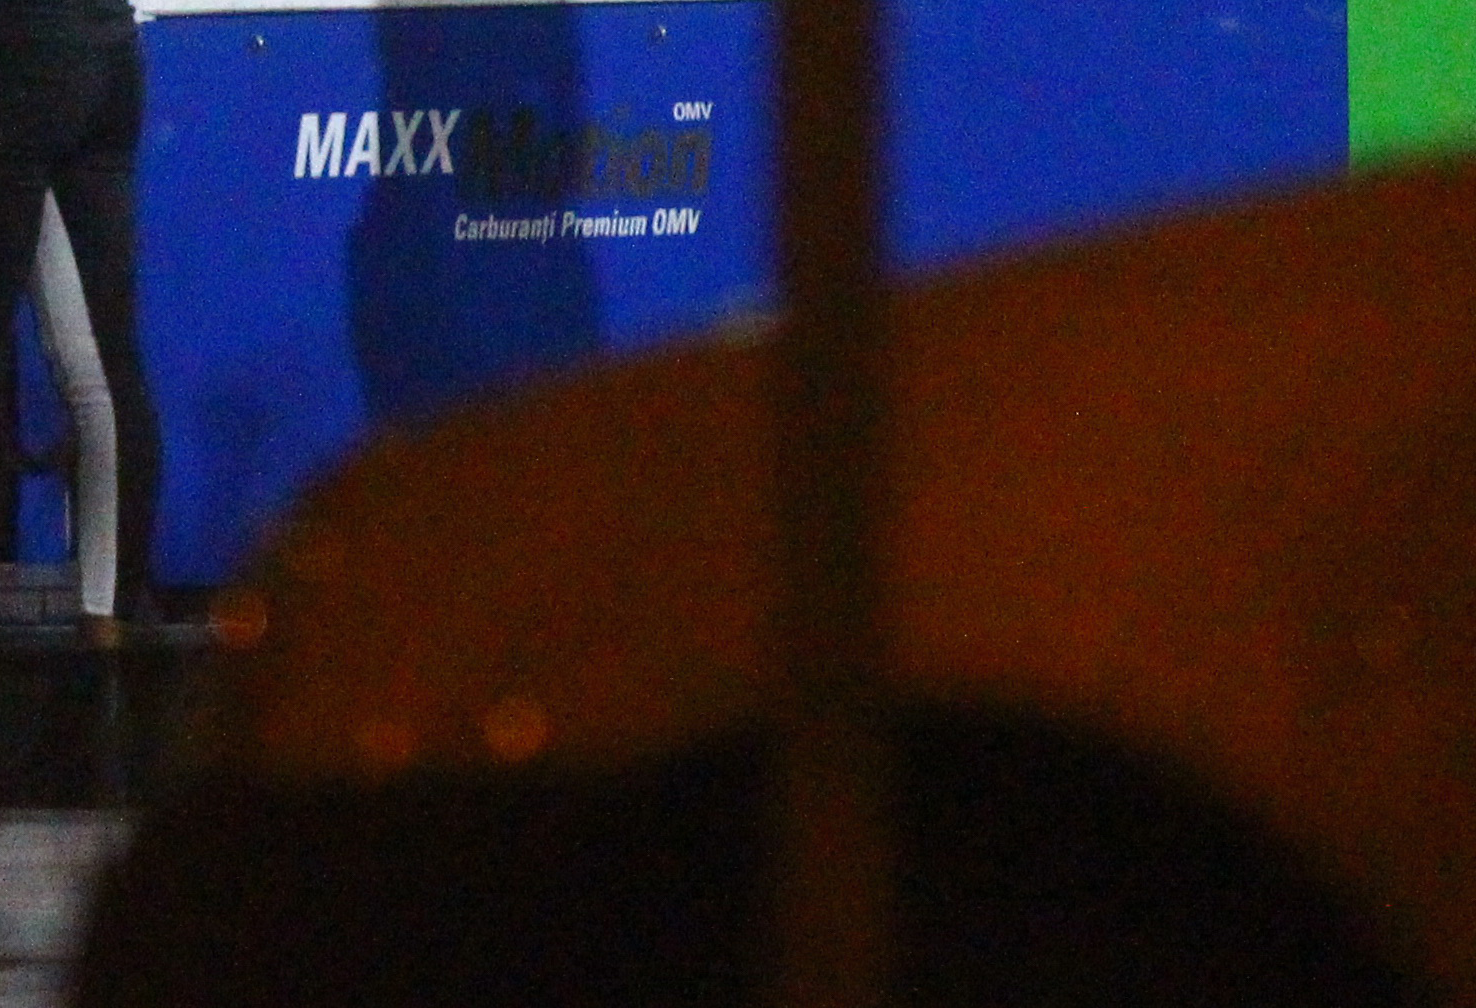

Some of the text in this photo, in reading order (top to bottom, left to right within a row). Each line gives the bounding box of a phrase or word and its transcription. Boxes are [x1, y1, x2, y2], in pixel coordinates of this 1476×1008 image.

[673, 102, 713, 121] OMV
[293, 108, 462, 179] MAXX
[561, 209, 648, 238] Premium
[652, 207, 700, 235] OMV
